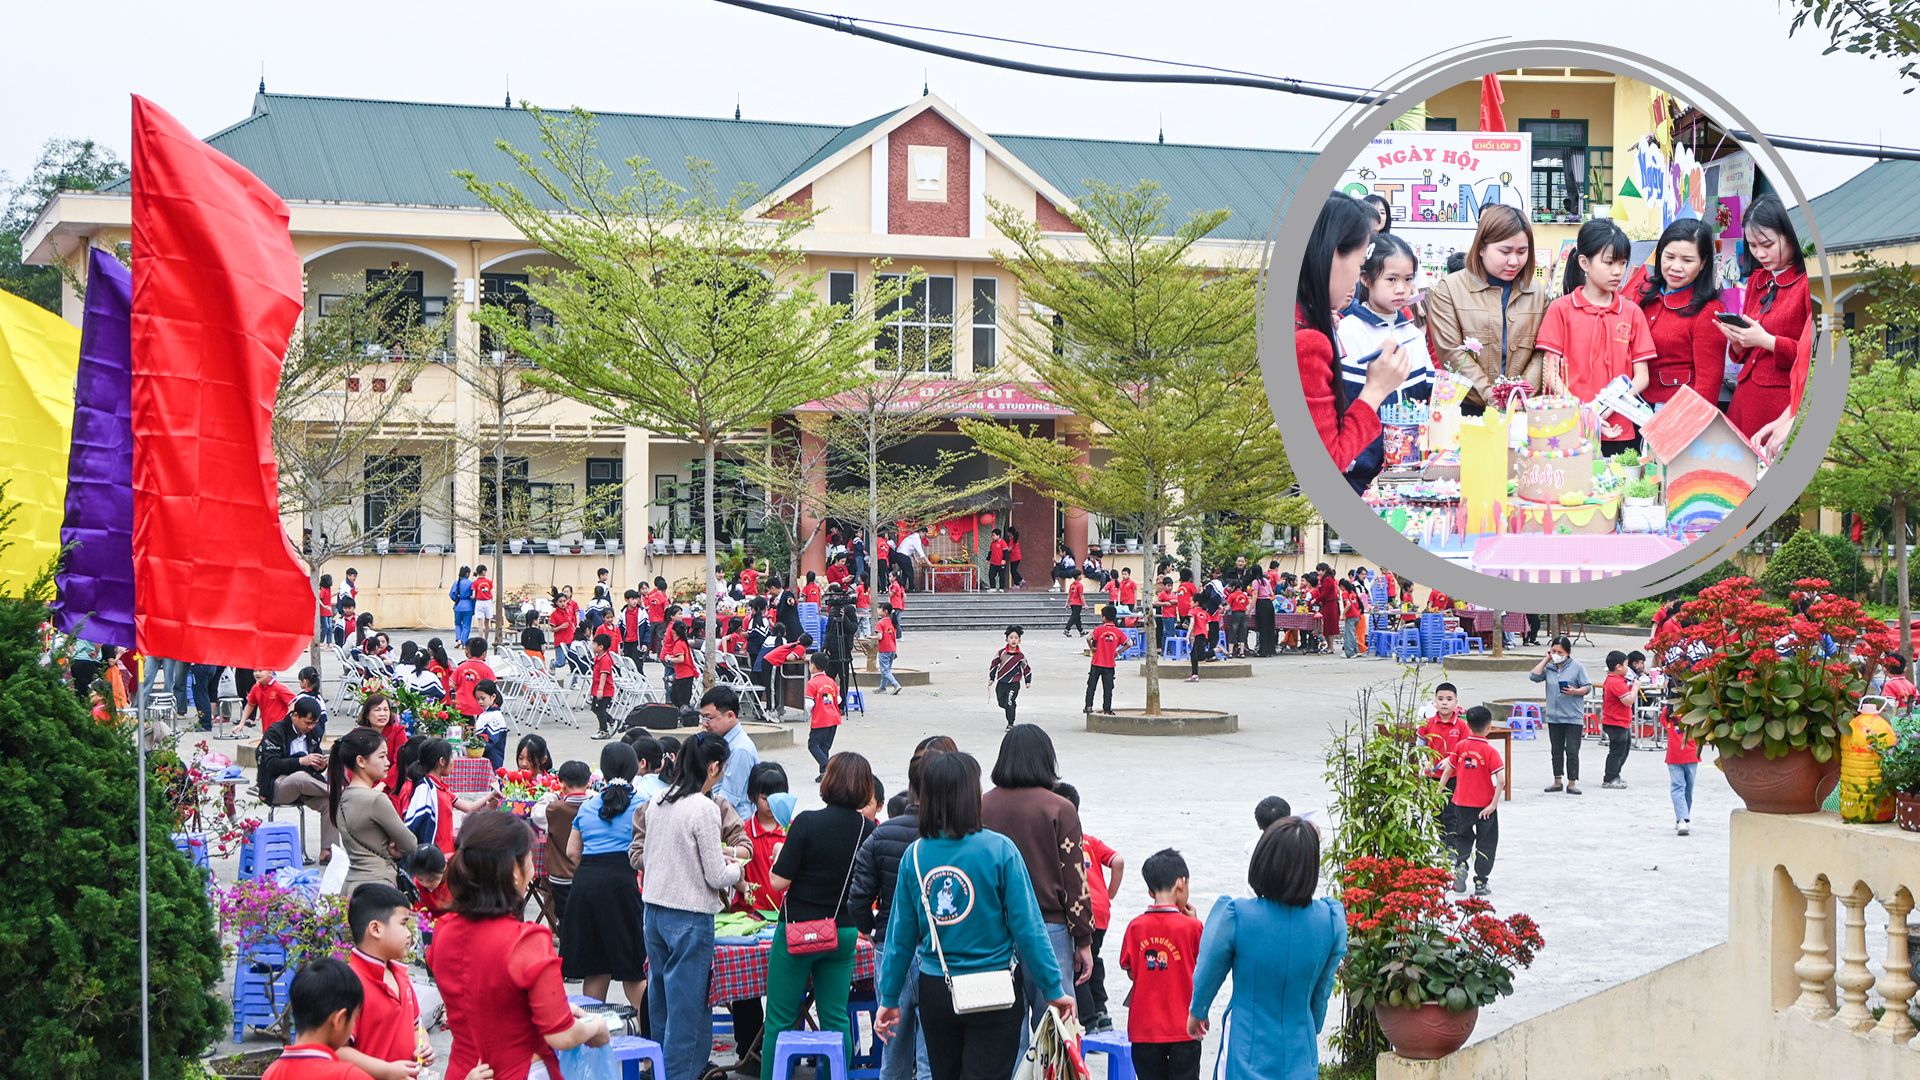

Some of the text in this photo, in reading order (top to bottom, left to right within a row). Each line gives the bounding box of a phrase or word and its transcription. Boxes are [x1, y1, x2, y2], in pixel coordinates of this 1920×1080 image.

[1475, 141, 1495, 149] KHỐI
[1496, 141, 1511, 149] LỚP
[1377, 145, 1480, 171] NGÀY HỘI
